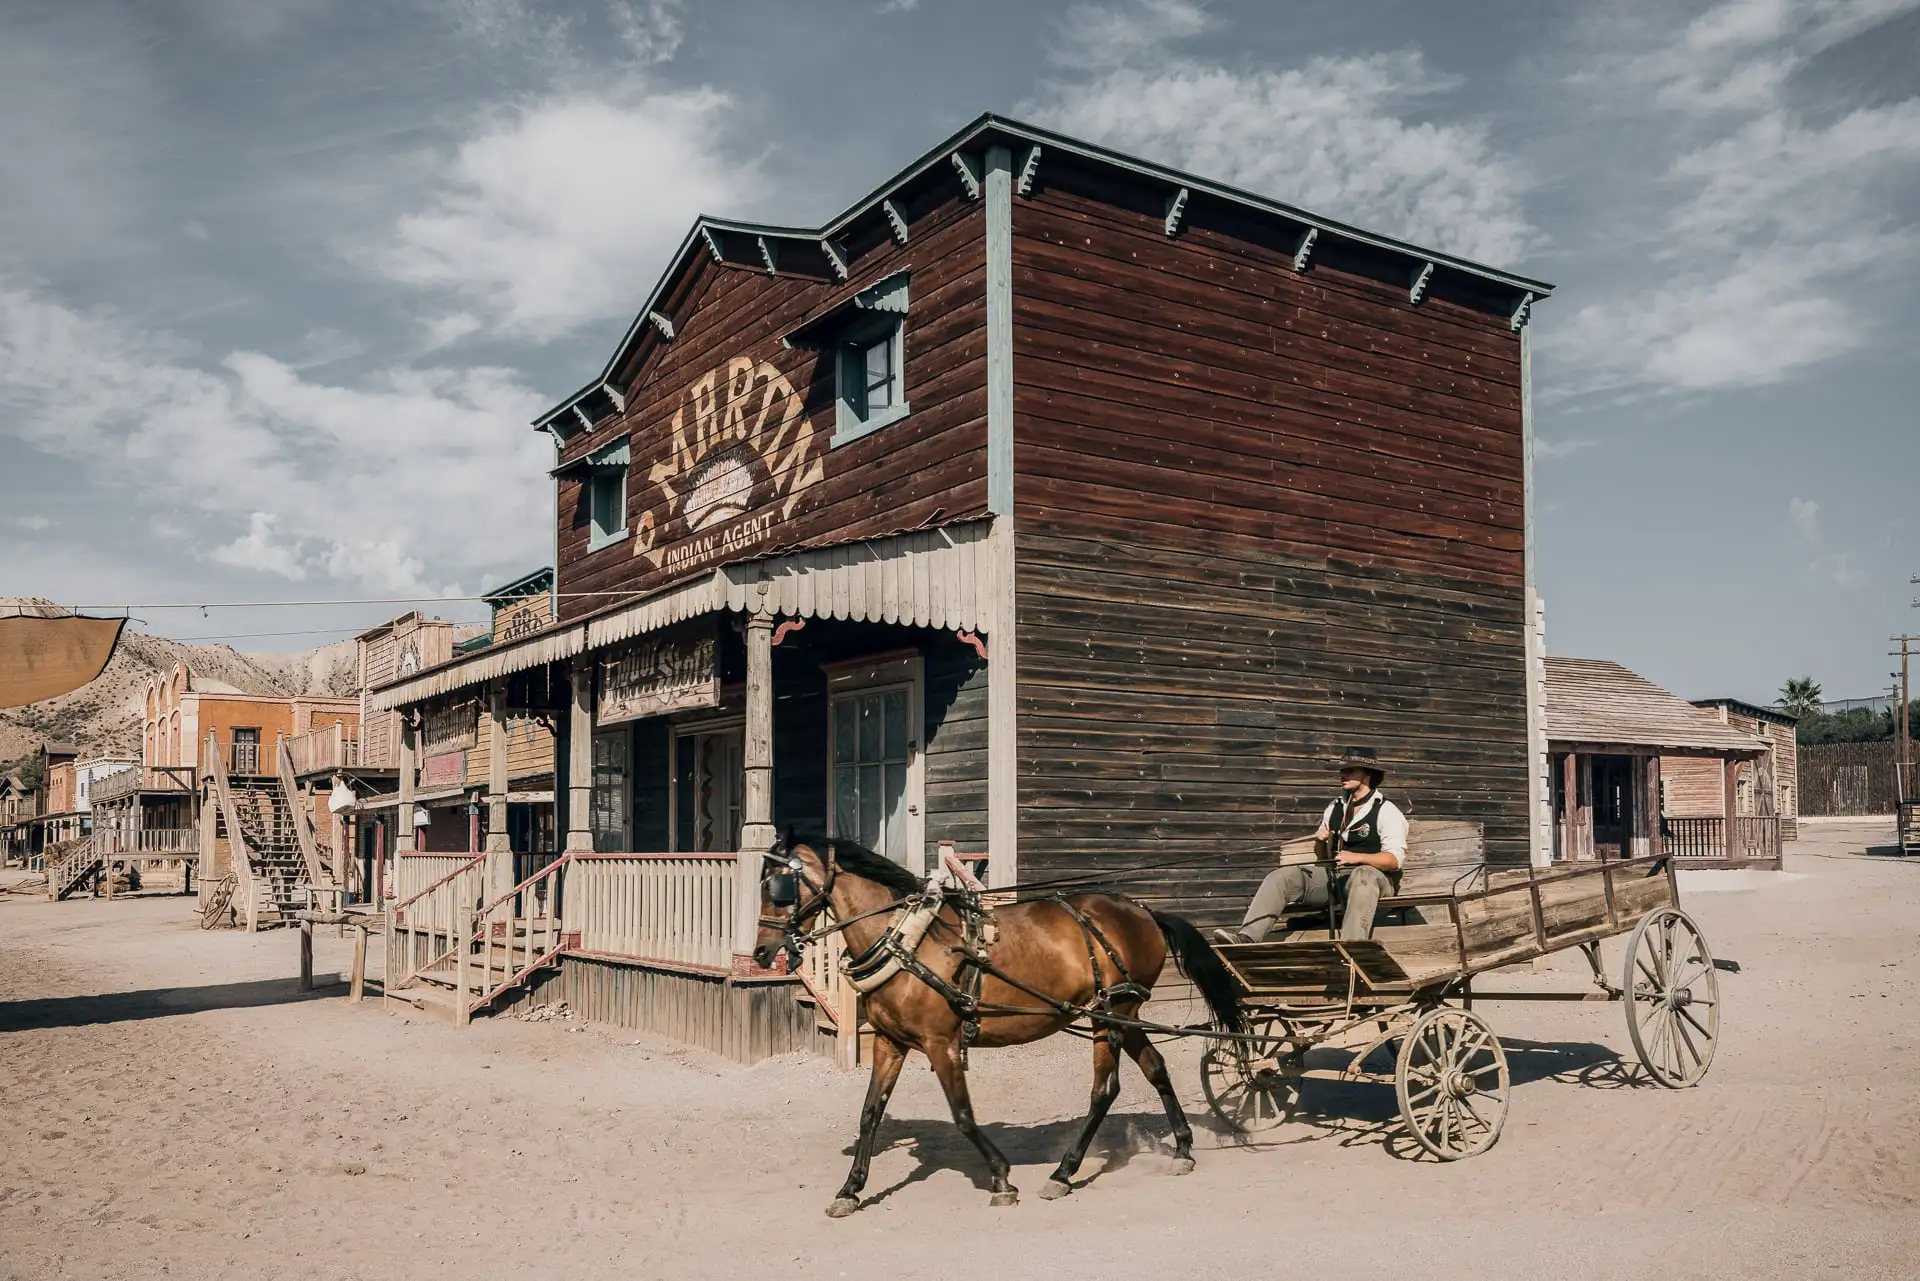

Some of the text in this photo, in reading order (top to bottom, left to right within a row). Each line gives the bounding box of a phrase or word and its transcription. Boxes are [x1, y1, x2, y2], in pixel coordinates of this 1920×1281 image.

[648, 356, 825, 525] MARTIN
[667, 511, 775, 574] INDIAN AGENT
